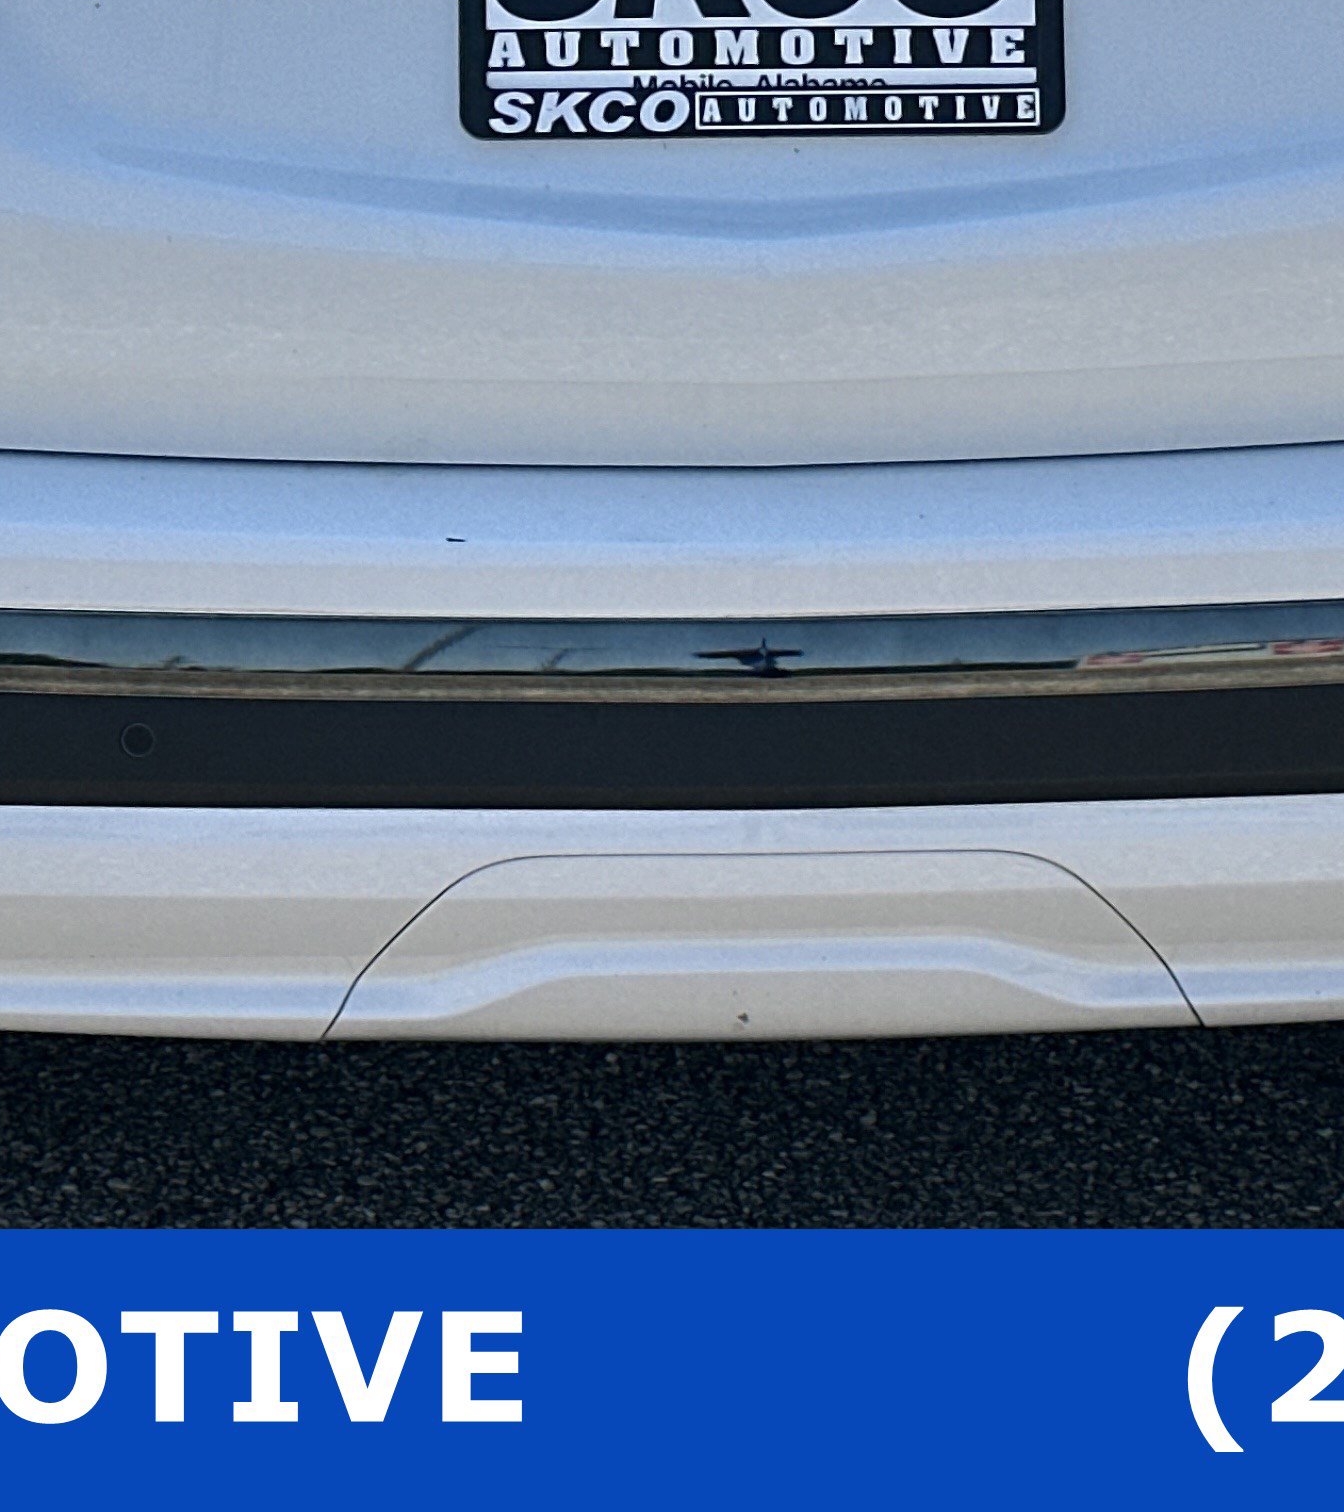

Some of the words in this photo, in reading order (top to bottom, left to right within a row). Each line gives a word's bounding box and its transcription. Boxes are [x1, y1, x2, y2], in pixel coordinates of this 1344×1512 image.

[488, 28, 1026, 69] AUTOMOTIVE
[488, 90, 690, 134] SKCO
[702, 94, 1037, 123] AUTOMOTIVE
